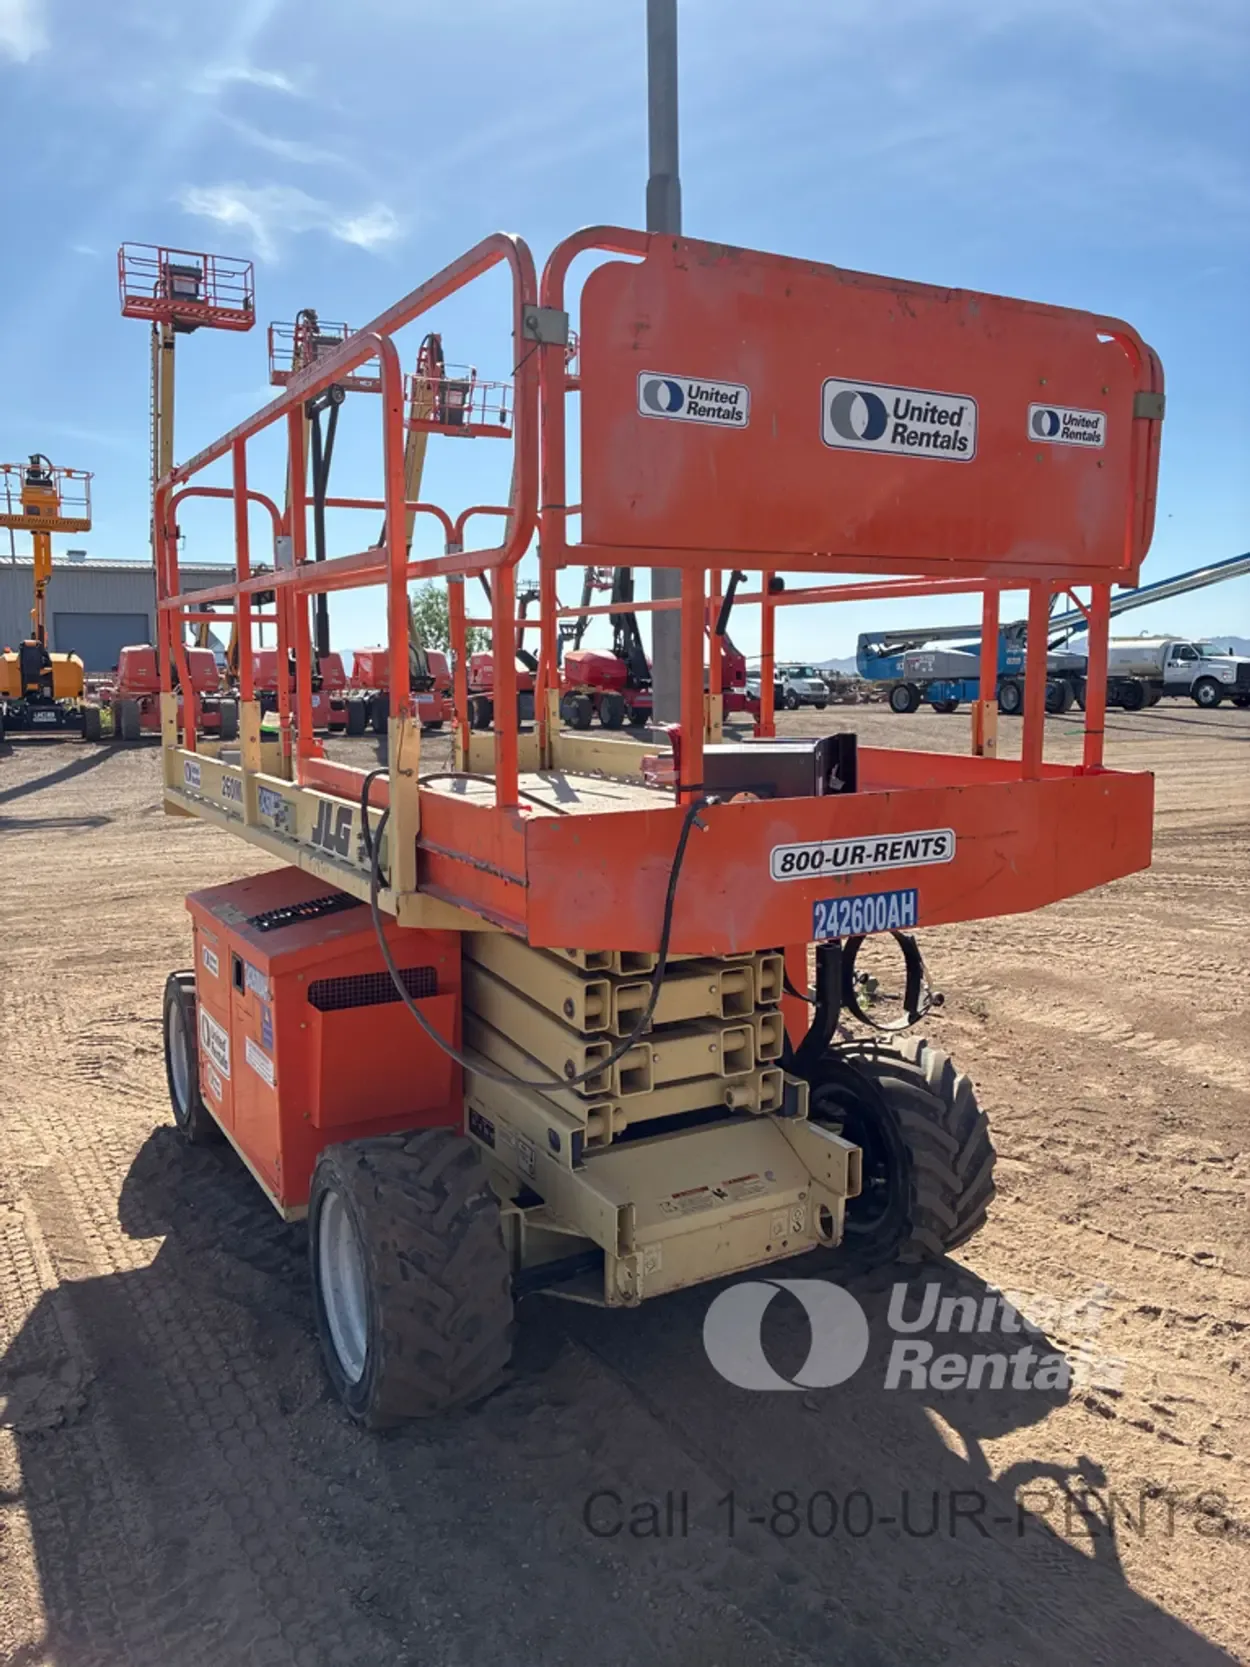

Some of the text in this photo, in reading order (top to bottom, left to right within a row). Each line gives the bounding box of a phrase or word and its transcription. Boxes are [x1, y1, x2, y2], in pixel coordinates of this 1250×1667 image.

[686, 385, 739, 405] United
[685, 402, 743, 422] Rentals
[892, 397, 965, 427] United
[1061, 413, 1100, 429] United
[890, 423, 969, 452] Rentals
[1060, 426, 1102, 443] Rentals
[311, 799, 353, 858] JLG
[780, 836, 947, 873] 800-UR-RENTS
[814, 890, 915, 939] 242600AH
